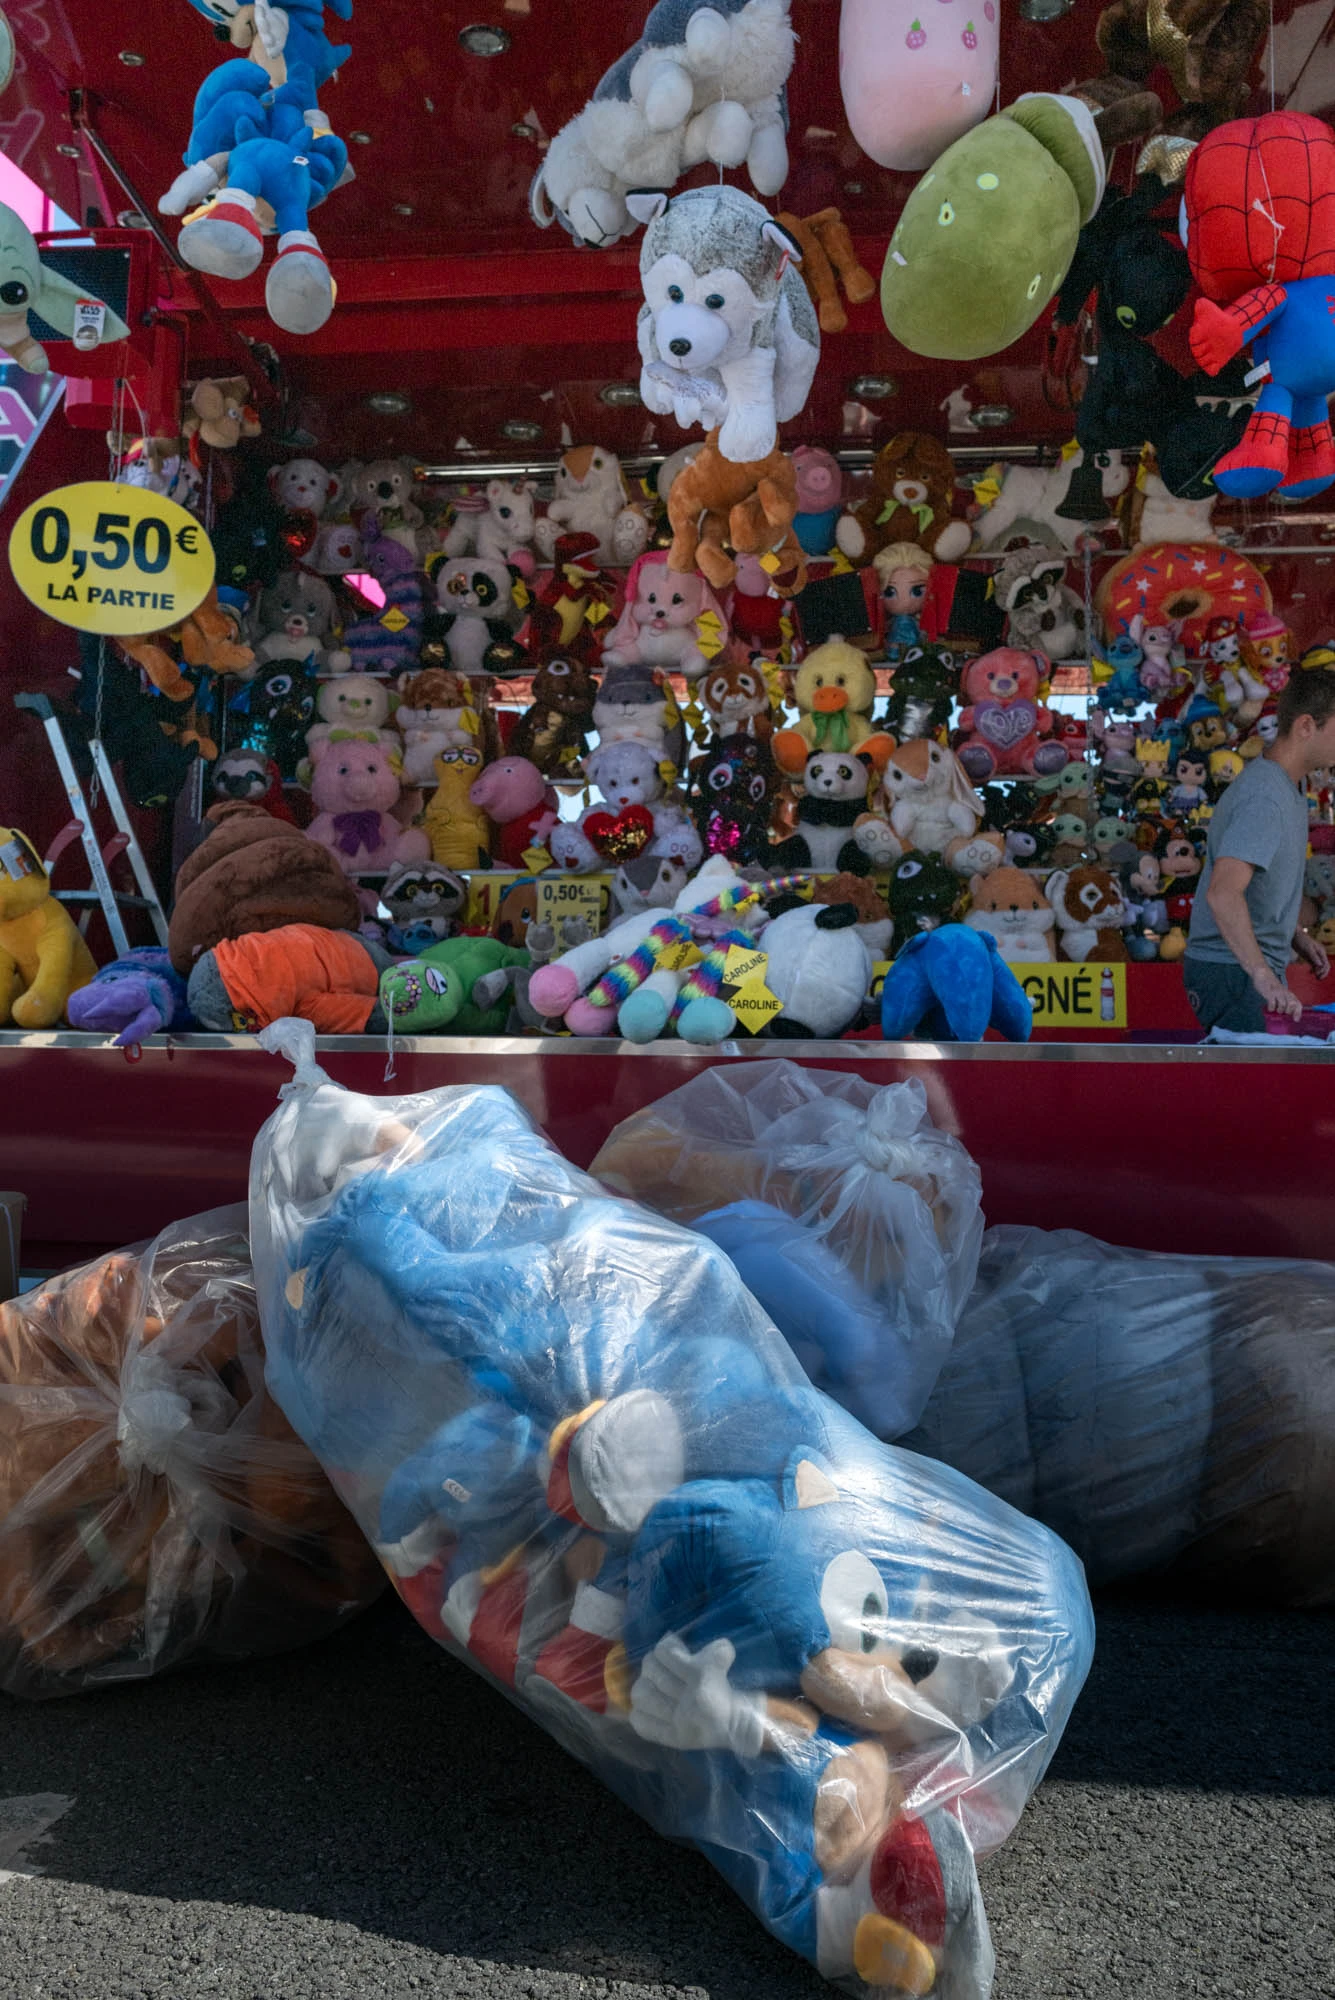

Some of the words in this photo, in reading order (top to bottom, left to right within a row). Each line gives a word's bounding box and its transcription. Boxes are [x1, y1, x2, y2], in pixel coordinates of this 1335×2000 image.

[31, 506, 198, 580] 0,50€
[47, 583, 78, 602] LA
[88, 587, 175, 611] PARTIE
[543, 884, 584, 904] 0,50€
[724, 953, 767, 983] CAROLINE
[728, 1000, 779, 1010] CAROLINE
[1022, 968, 1093, 1014] GNÉ
